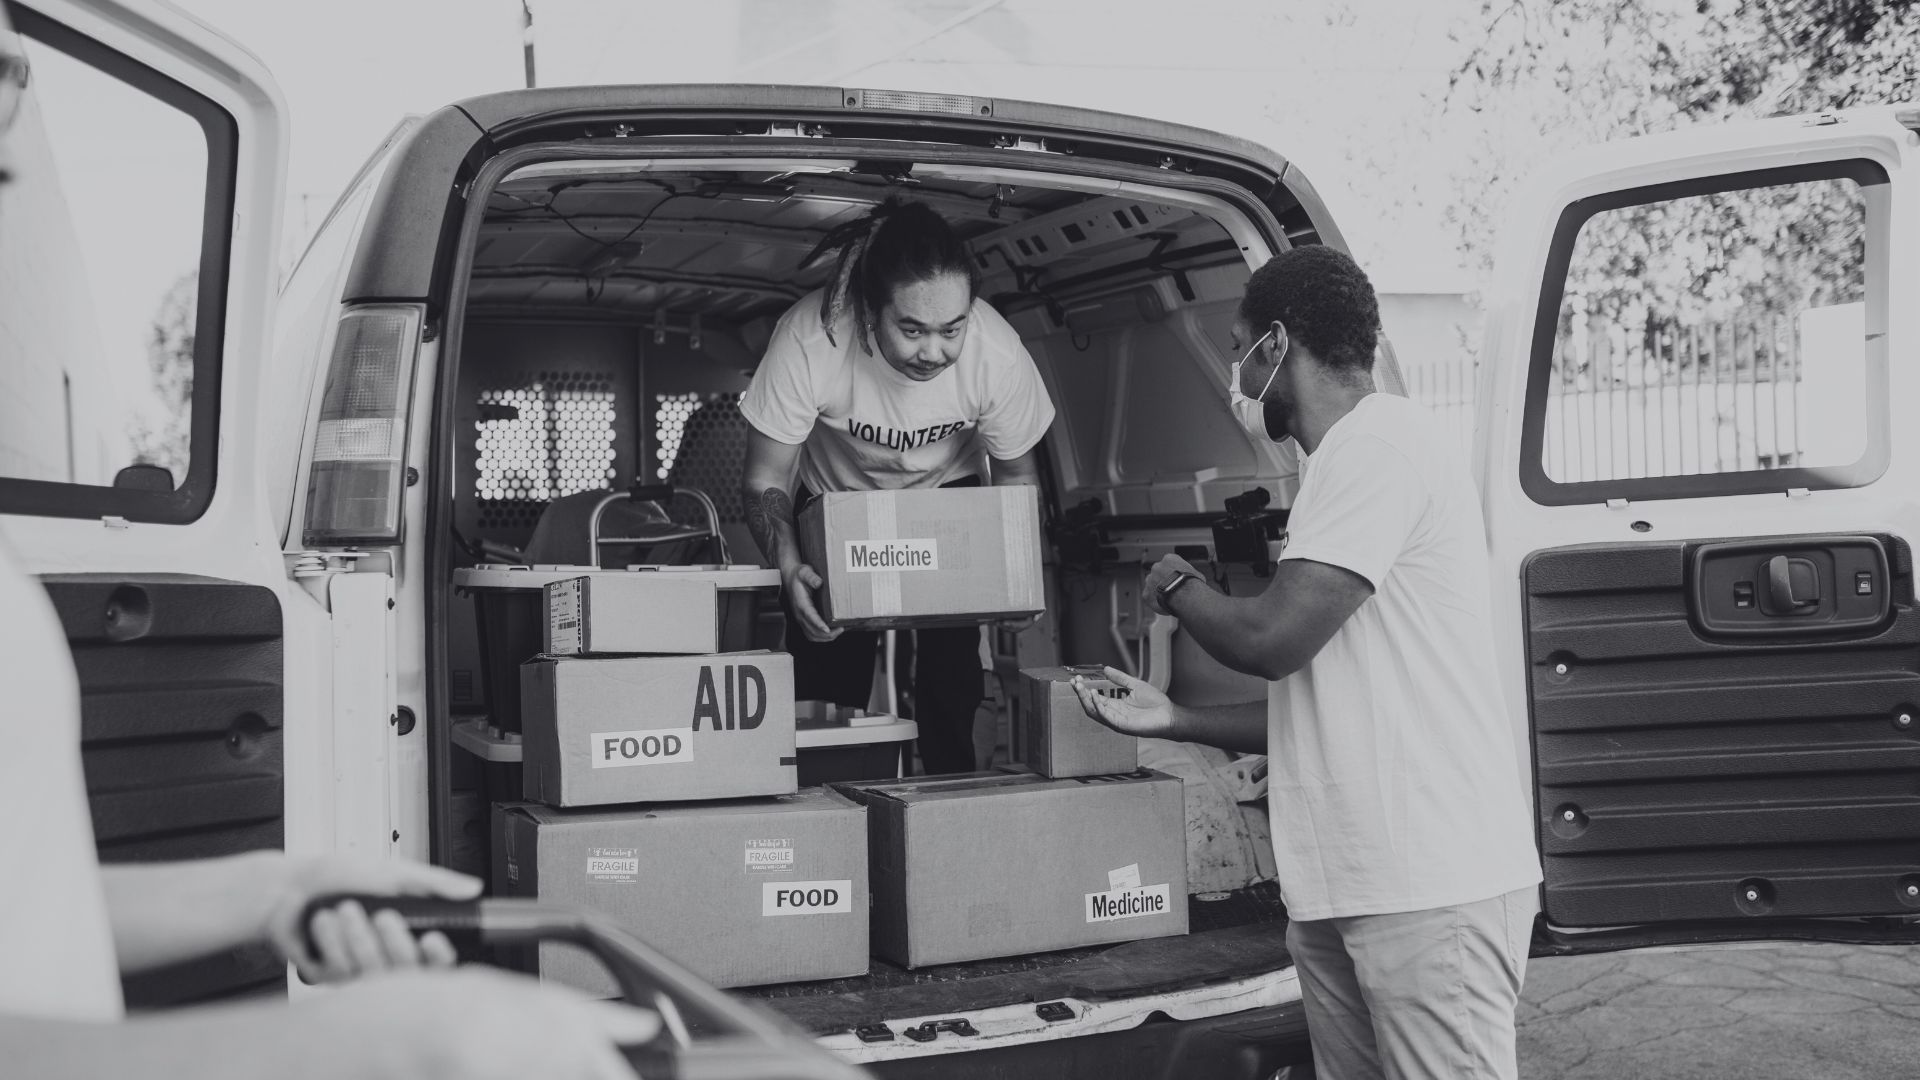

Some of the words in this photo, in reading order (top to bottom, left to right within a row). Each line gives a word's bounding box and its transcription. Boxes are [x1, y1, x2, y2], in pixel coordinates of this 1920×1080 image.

[848, 418, 965, 452] VOLUNTEER
[850, 544, 932, 567] Medicine
[692, 664, 767, 731] AID
[603, 734, 682, 760] FOOD
[592, 861, 635, 871] FRAGILE
[750, 851, 791, 862] FRAGILE
[776, 888, 839, 908] FOOD
[1092, 890, 1164, 918] Medicine
